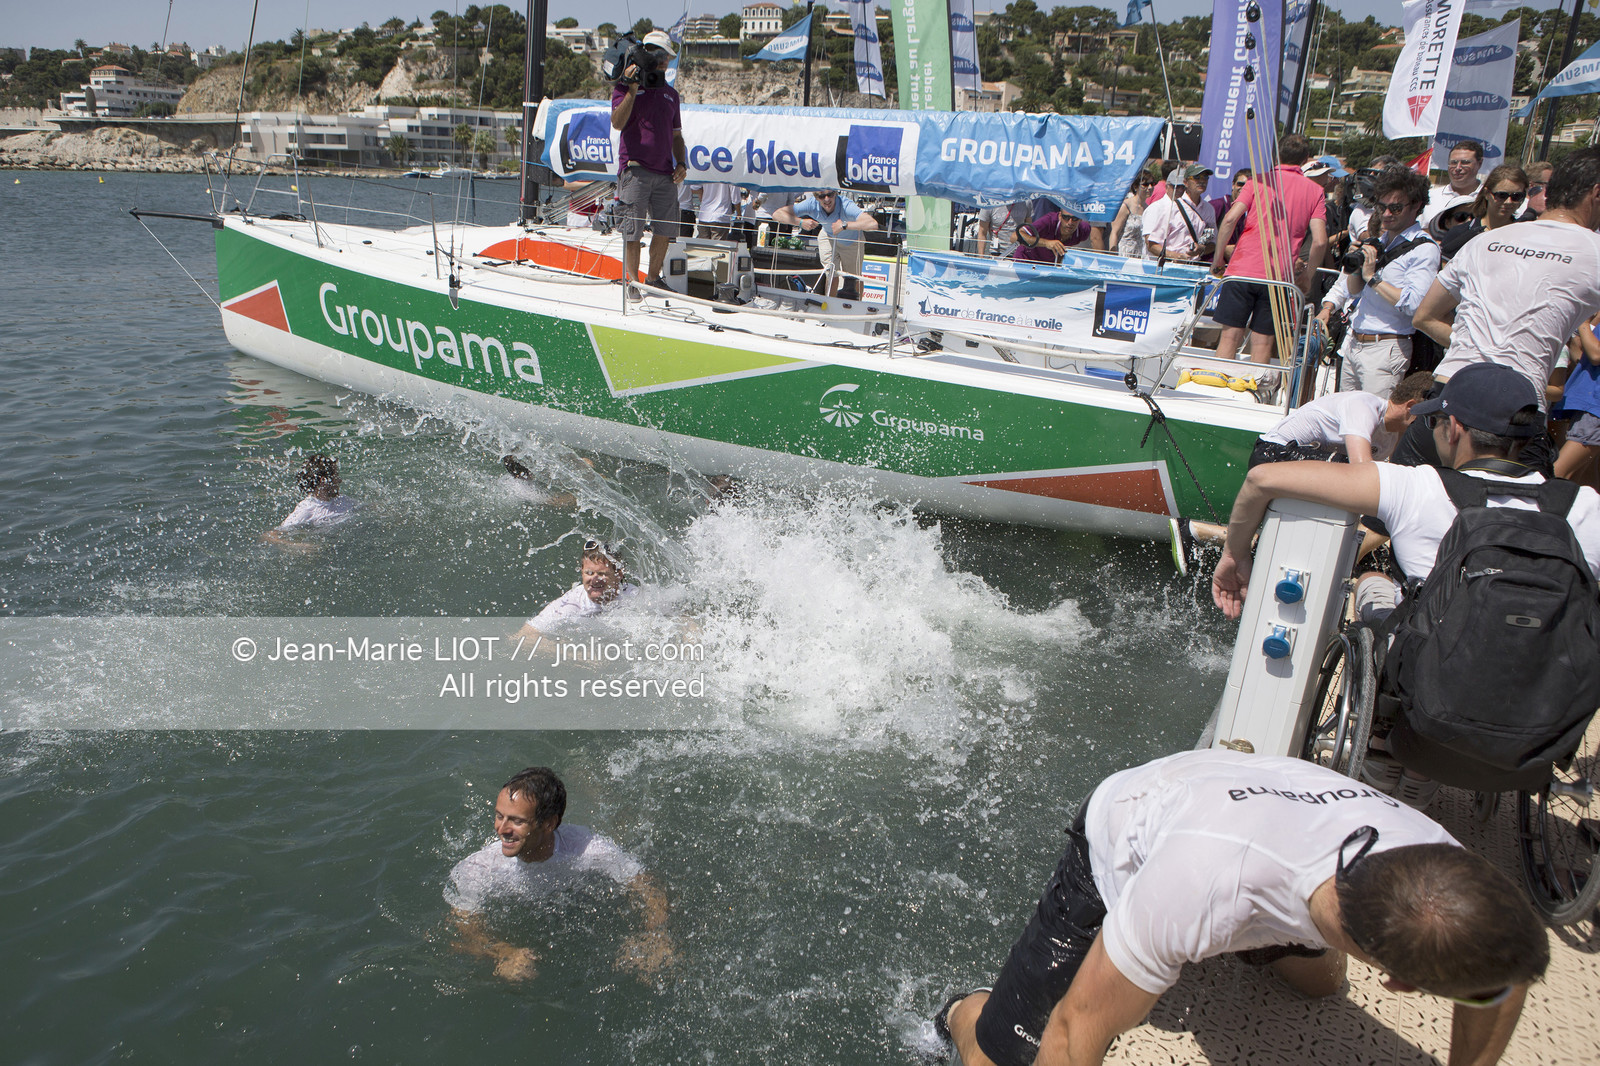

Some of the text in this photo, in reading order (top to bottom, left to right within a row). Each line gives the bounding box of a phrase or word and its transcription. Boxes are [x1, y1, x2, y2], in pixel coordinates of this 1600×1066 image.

[1409, 77, 1418, 92] CCS
[569, 140, 612, 162] bleu
[587, 136, 610, 145] france
[746, 138, 821, 178] bleu
[868, 154, 897, 165] france
[940, 138, 1135, 170] GROUPAMA 34
[848, 158, 897, 184] bleu
[1487, 242, 1573, 264] Groupama
[933, 304, 959, 317] tour
[961, 308, 974, 319] de
[975, 309, 1016, 324] france
[1034, 318, 1063, 331] voile
[1104, 309, 1147, 332] bleu
[1123, 307, 1148, 318] france
[319, 282, 543, 385] Groupama
[871, 410, 984, 441] Groupama
[1228, 786, 1400, 808] Groupama
